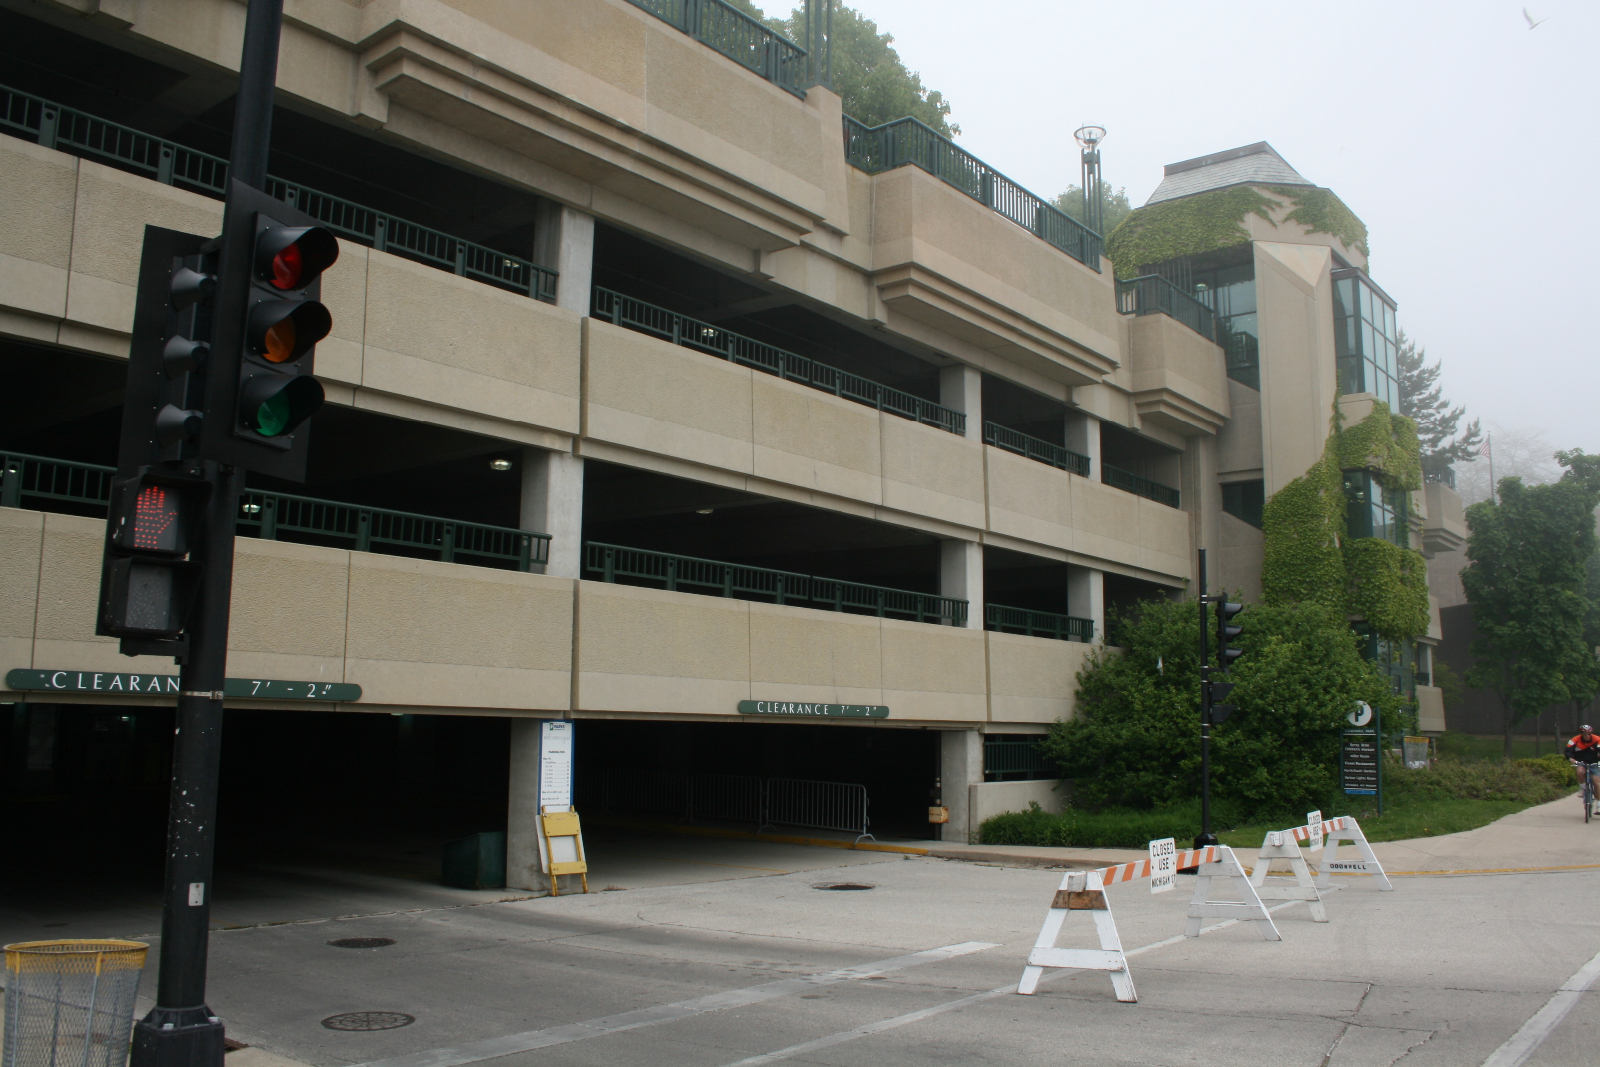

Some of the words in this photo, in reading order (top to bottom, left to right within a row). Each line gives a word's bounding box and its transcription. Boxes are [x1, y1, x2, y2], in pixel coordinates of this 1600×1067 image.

[51, 670, 181, 693] CLEARAN
[757, 701, 829, 715] CLEARANCE
[1354, 704, 1365, 722] P
[1309, 814, 1321, 826] CLOSED
[1152, 841, 1174, 857] CLOSED
[1158, 857, 1170, 871] USE
[1151, 875, 1170, 888] MICHIGAN
[1170, 873, 1176, 884] ST
